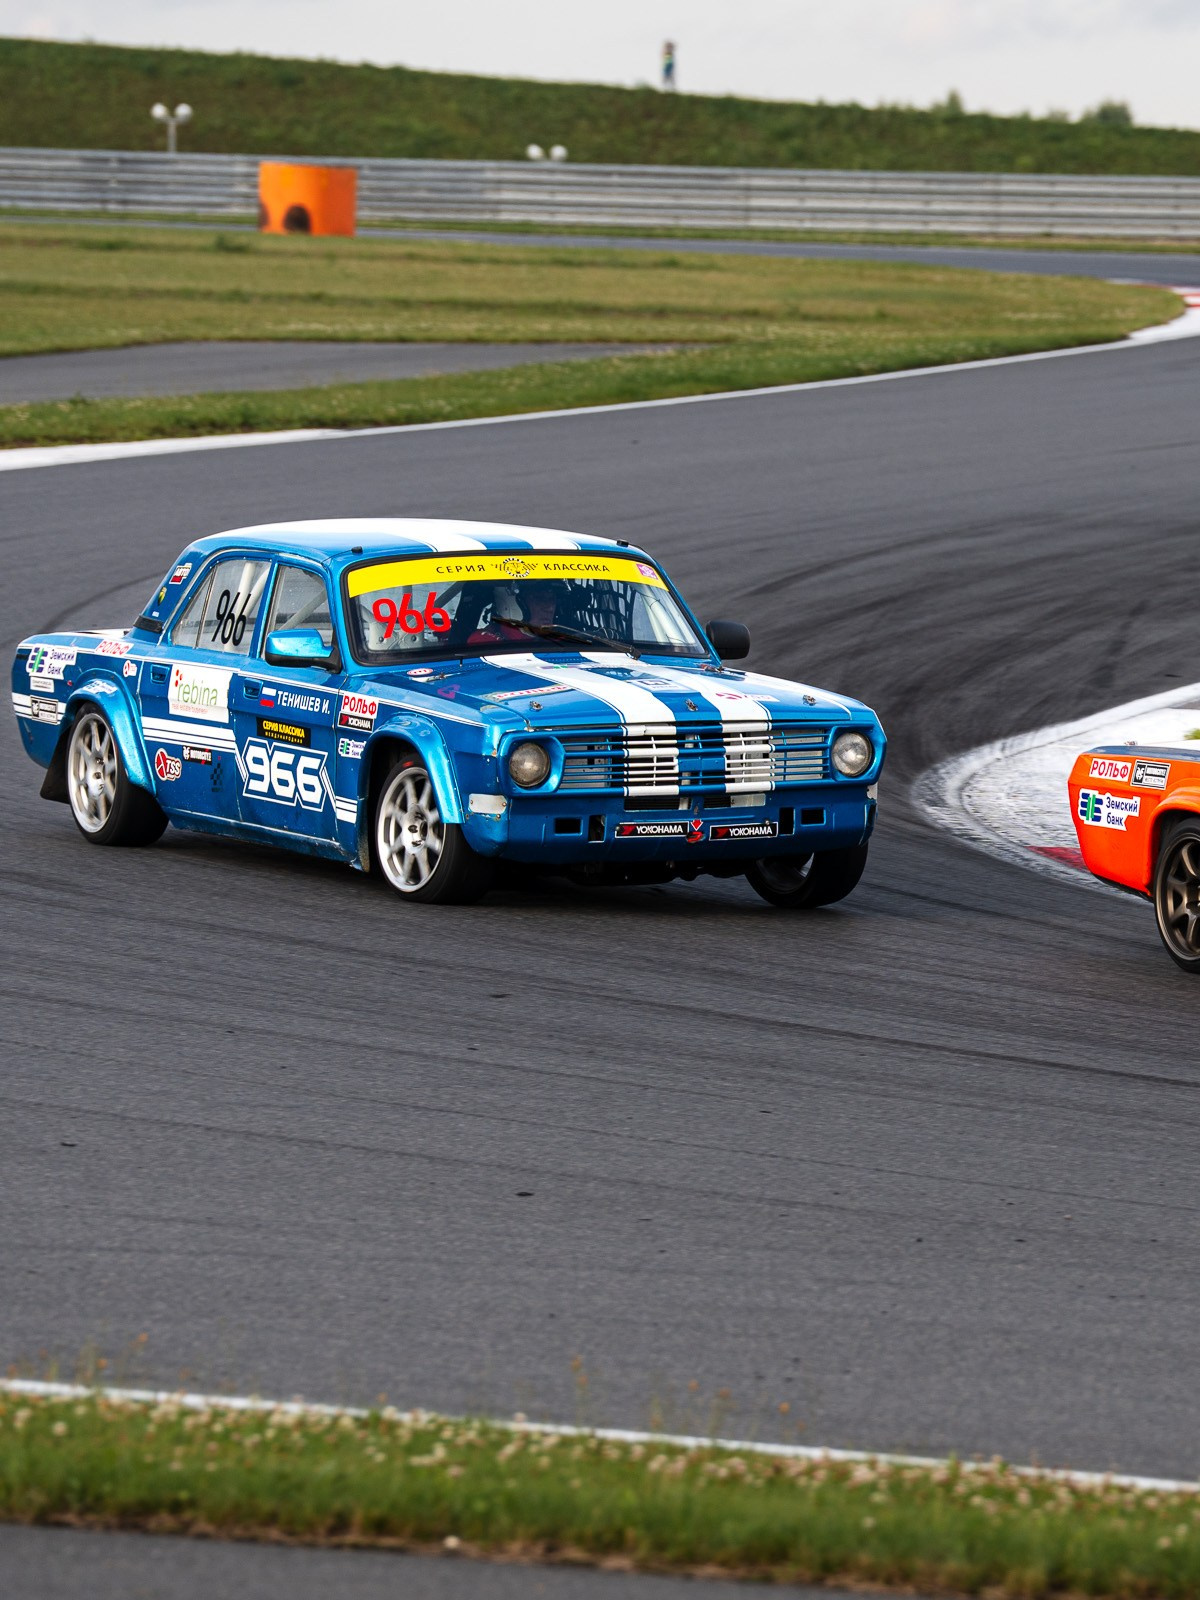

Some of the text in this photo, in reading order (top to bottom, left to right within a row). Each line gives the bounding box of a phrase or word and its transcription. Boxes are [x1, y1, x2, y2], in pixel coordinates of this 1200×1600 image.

[436, 563, 610, 574] СЕРИЯ КЛАССИКА
[211, 589, 252, 646] 966
[371, 591, 451, 639] 966
[96, 640, 130, 656] РОЛЬФ
[47, 663, 62, 675] банк
[178, 680, 219, 706] rebina
[277, 691, 331, 715] ТЕНИШЕВ И.
[342, 695, 377, 715] РОЛЬФ
[262, 720, 305, 738] СЕРИЯ КЛАССИКА
[166, 759, 181, 776] TSS
[245, 745, 323, 804] 966
[1091, 760, 1129, 779] РОЛЬФ
[1106, 796, 1138, 813] Земский
[1106, 812, 1124, 826] банк
[636, 825, 684, 834] YOKOHAMA
[729, 825, 773, 836] YOKOHAMA
